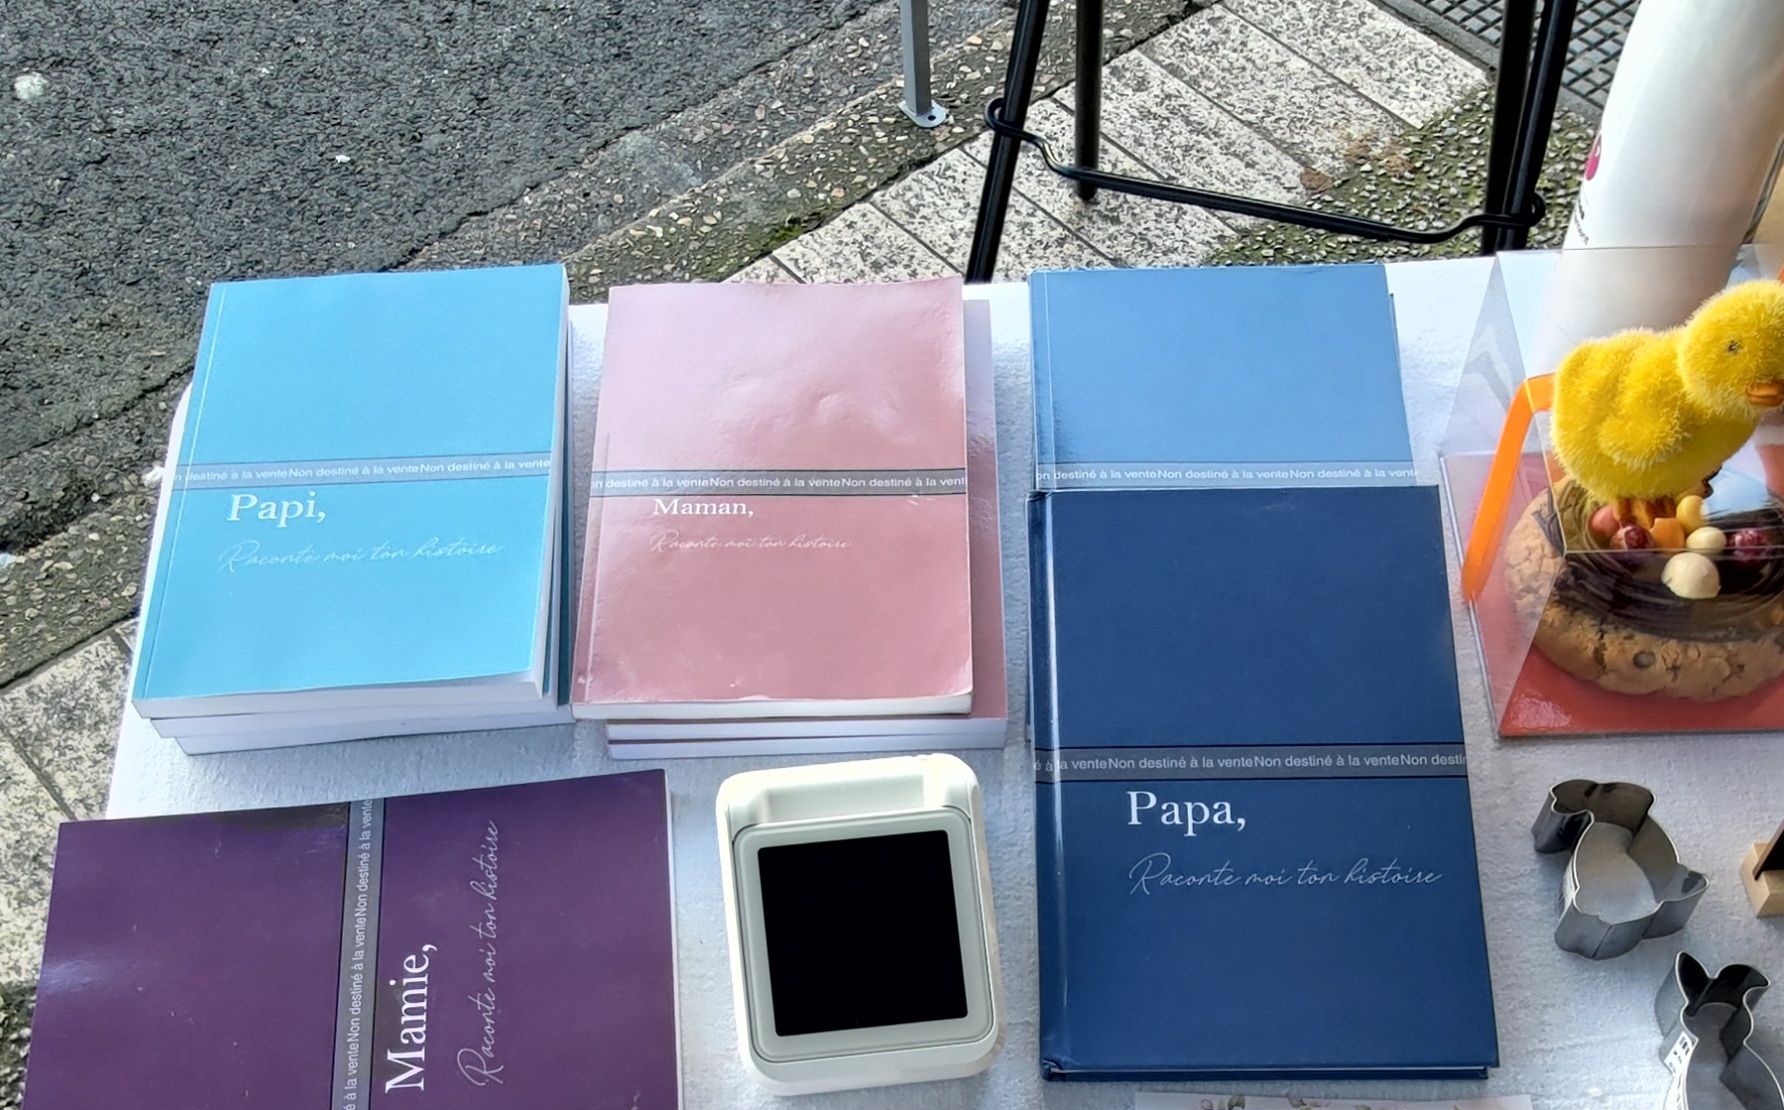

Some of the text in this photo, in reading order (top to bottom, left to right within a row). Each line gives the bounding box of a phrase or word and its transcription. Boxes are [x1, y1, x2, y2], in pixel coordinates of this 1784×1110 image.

[1100, 468, 1108, 479] à
[1111, 469, 1121, 479] la
[1232, 468, 1240, 479] à
[1243, 469, 1253, 478] la
[1364, 468, 1372, 477] à
[1375, 468, 1386, 478] la
[1389, 469, 1416, 478] vent
[227, 492, 326, 527] Papi,
[653, 499, 754, 518] Maman,
[218, 540, 318, 572] Raconte
[323, 544, 366, 563] moi
[413, 537, 502, 558] histoire
[650, 529, 723, 552] Raconte
[727, 537, 754, 548] moi
[788, 532, 851, 549] histoire
[1139, 756, 1186, 769] destiné
[1190, 755, 1198, 768] à
[1202, 755, 1214, 768] la
[1285, 754, 1332, 767] destiné
[1337, 753, 1344, 767] à
[1348, 754, 1360, 767] la
[1126, 790, 1246, 837] Papa,
[1129, 852, 1441, 895] Raconte moi ton histoire
[457, 820, 503, 1087] Raconte moi ton histoire
[385, 943, 437, 1094] Mamie,
